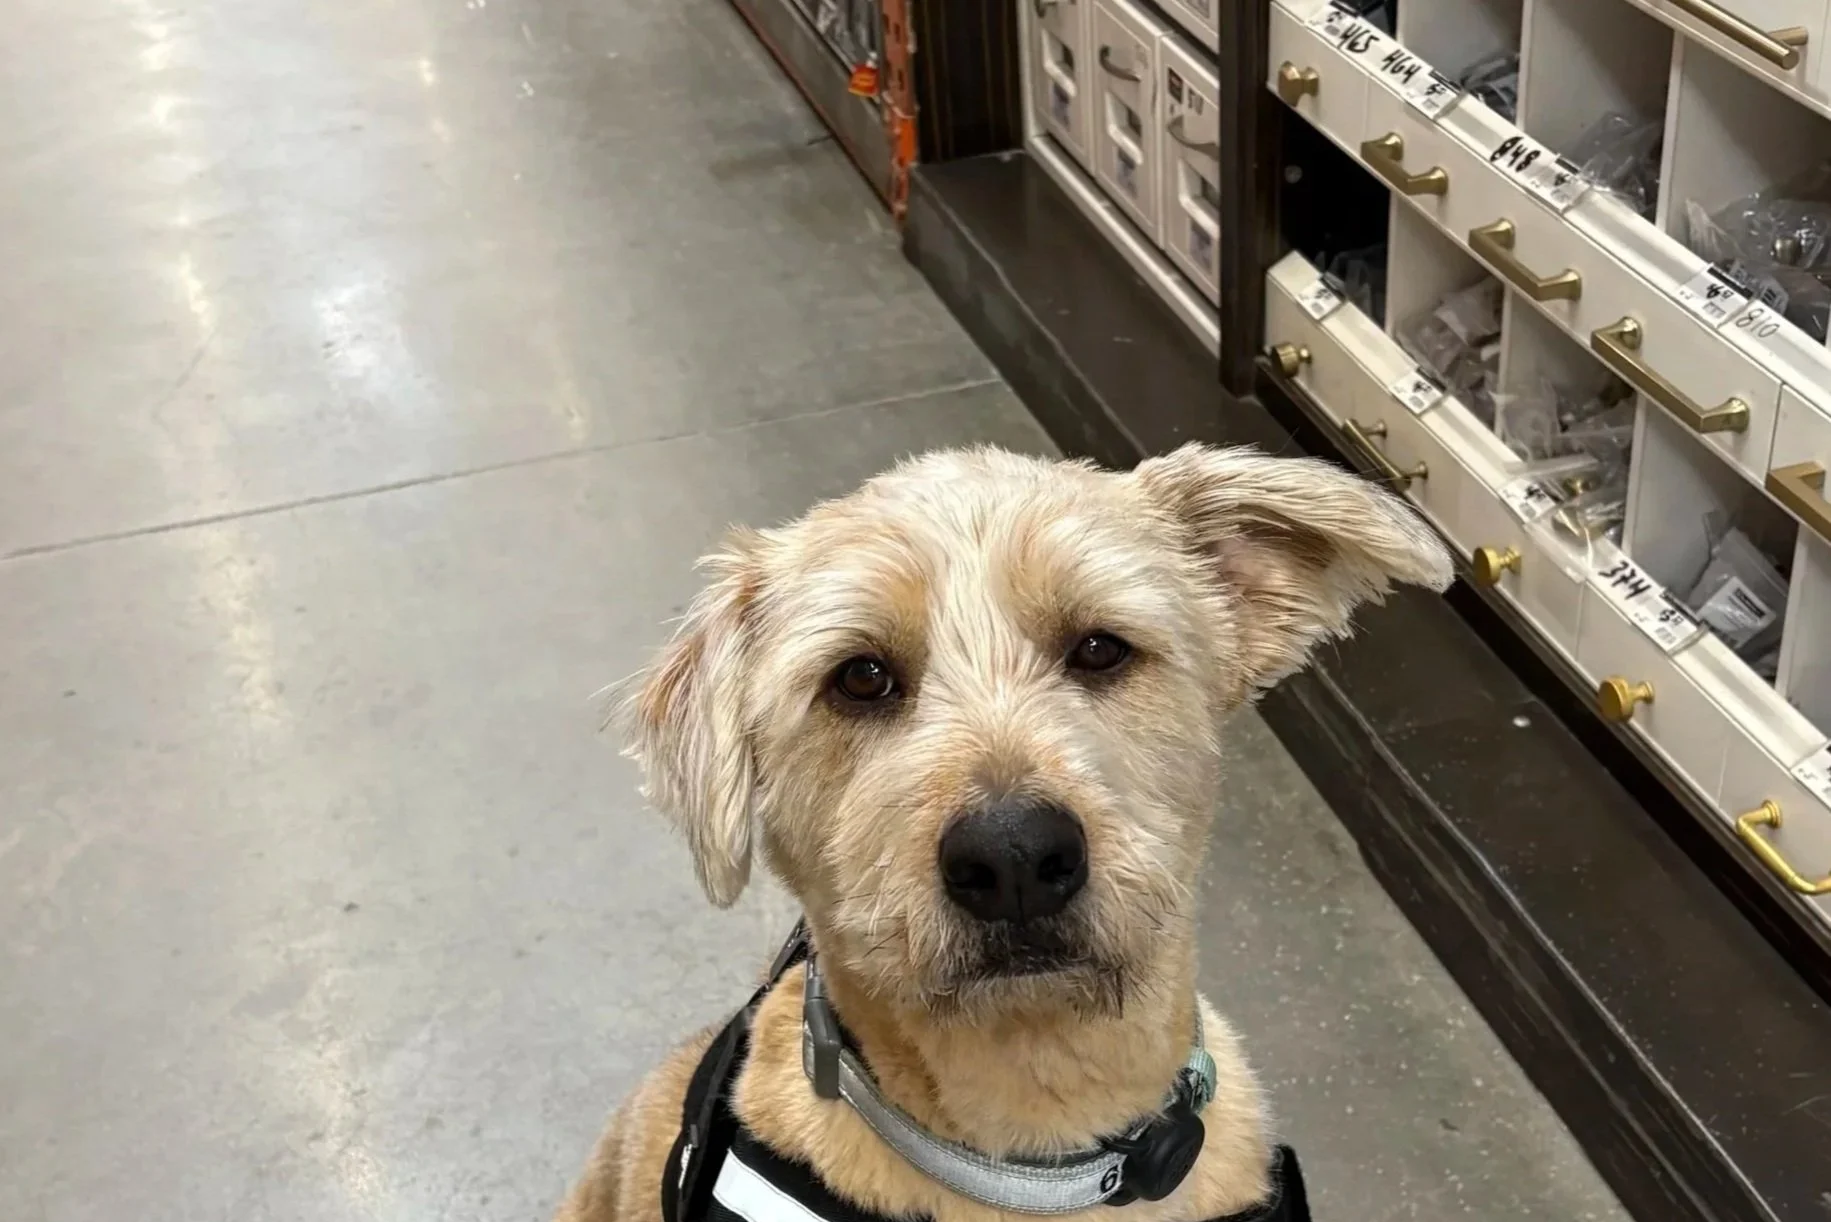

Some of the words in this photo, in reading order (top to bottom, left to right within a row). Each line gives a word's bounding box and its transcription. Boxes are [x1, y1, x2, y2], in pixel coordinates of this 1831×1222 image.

[1337, 23, 1381, 53] 465
[1381, 49, 1423, 85] 464
[1735, 307, 1780, 338] 810
[1597, 560, 1652, 600] 374
